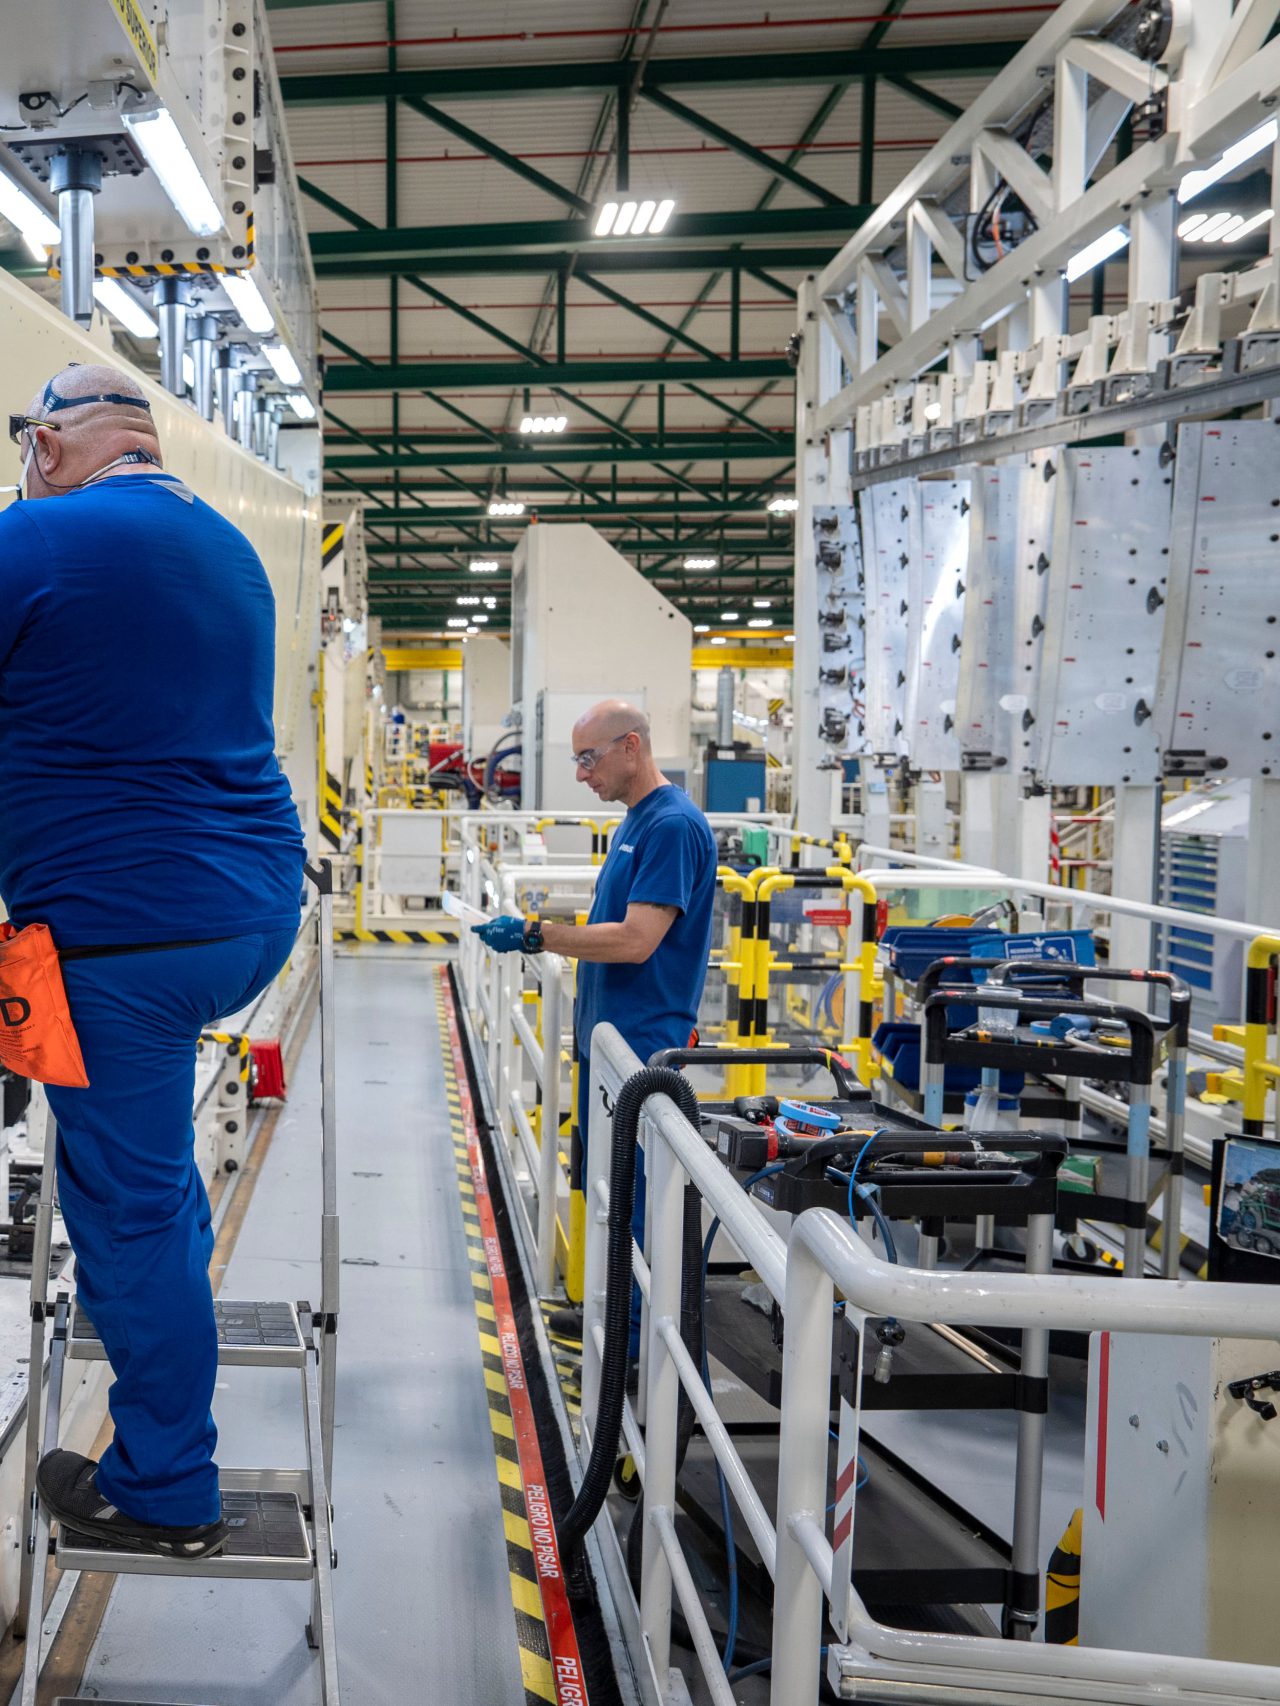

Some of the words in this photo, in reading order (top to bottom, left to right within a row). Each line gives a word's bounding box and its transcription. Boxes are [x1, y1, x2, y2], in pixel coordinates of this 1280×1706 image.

[527, 1484, 549, 1526] PELIGRO
[532, 1527, 552, 1544] NO
[536, 1545, 559, 1579] PISAR
